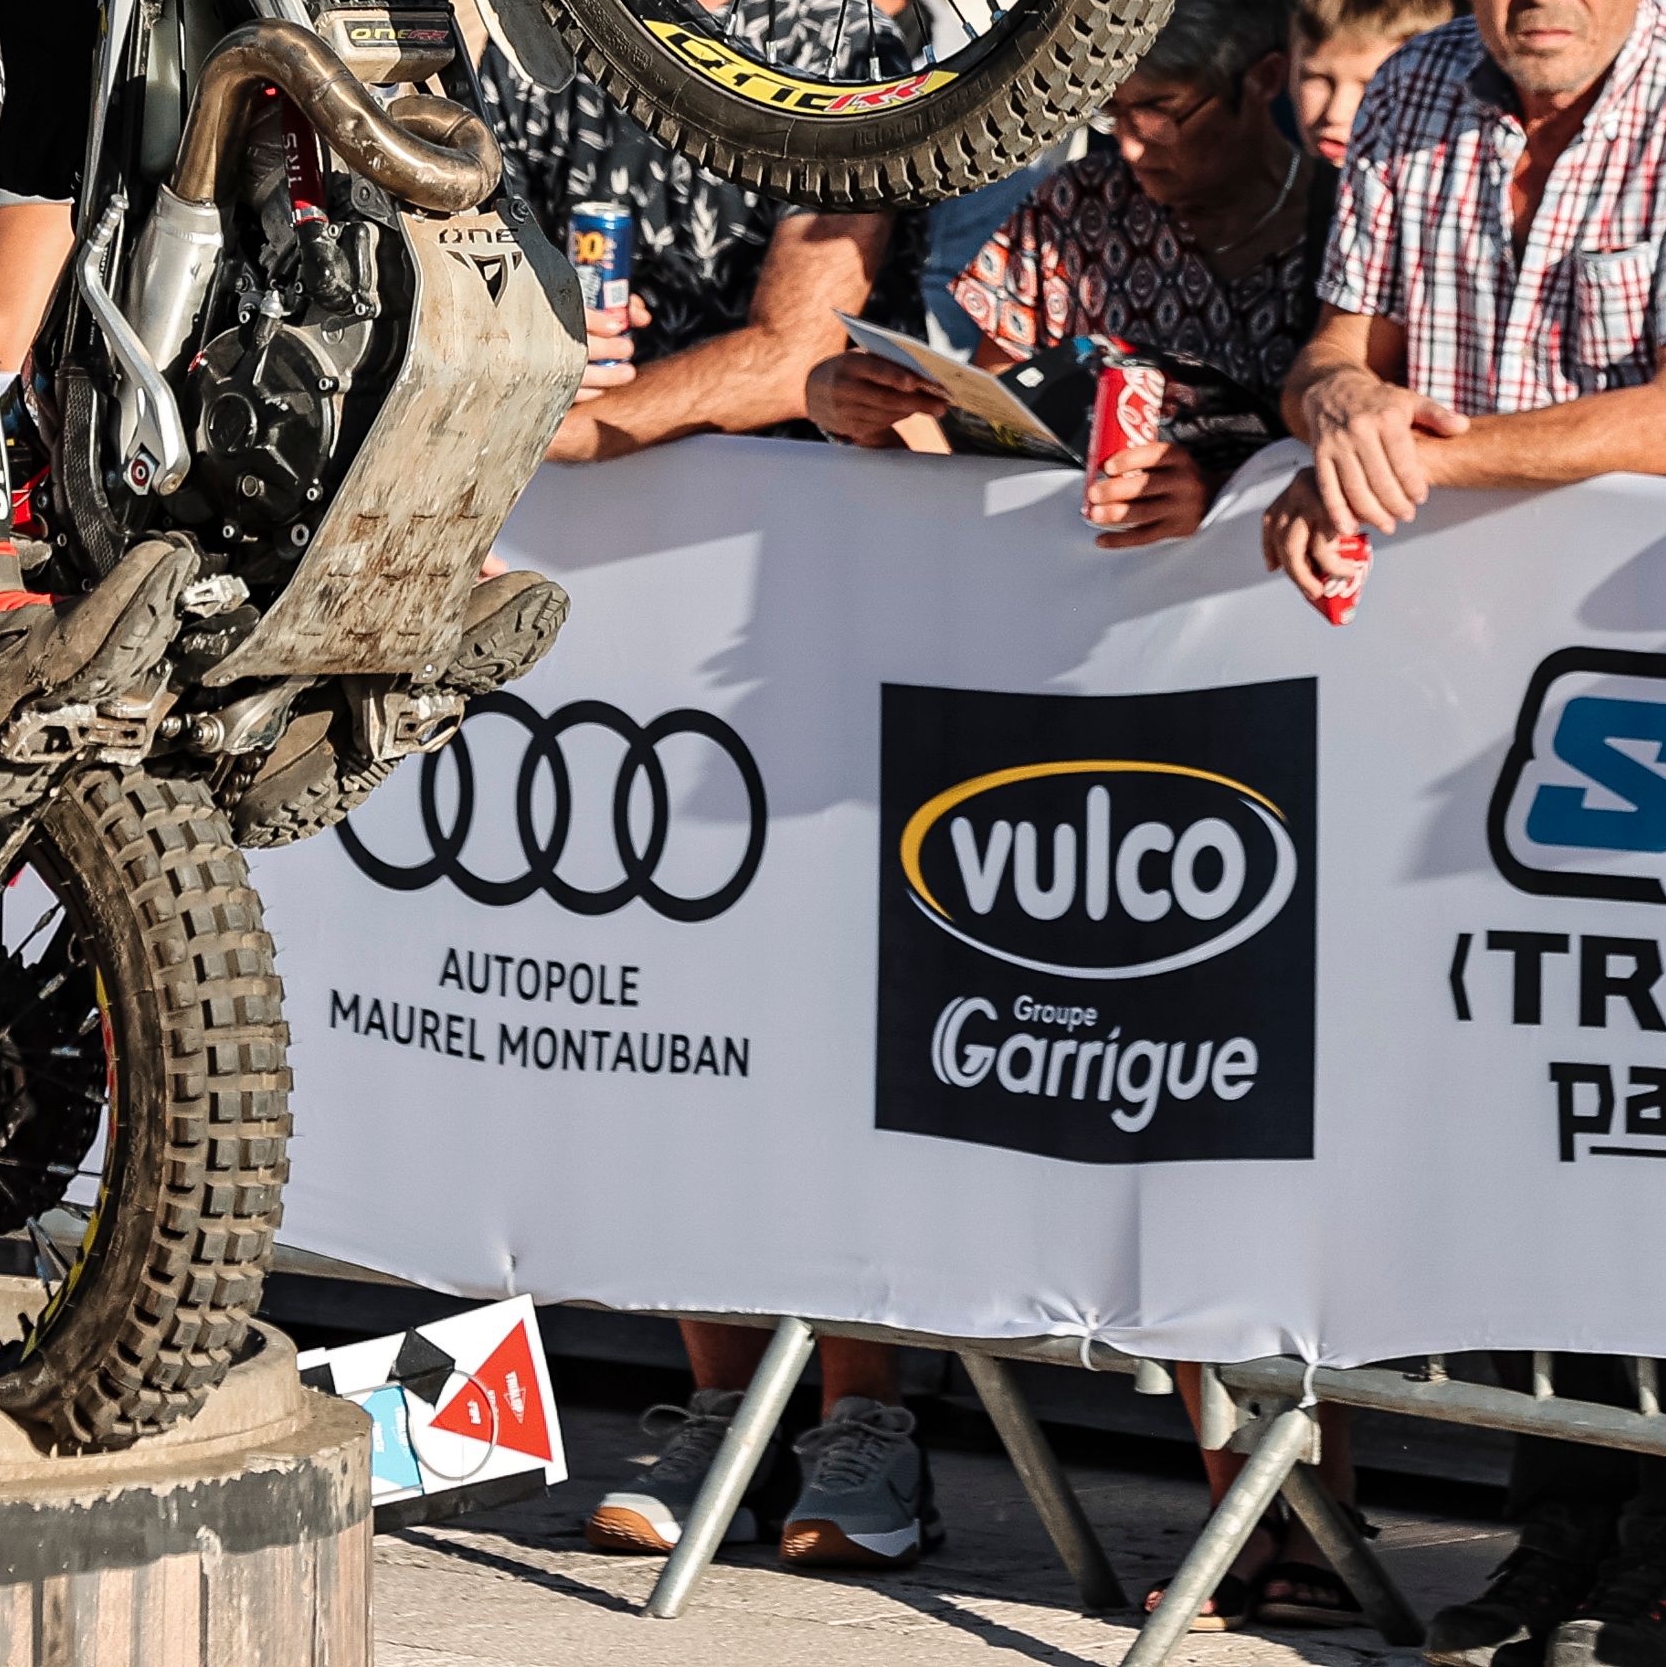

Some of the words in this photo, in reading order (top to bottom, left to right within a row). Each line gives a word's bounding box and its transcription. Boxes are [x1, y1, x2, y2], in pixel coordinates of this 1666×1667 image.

[437, 947, 640, 1007] AUTOPOLE
[329, 989, 487, 1063] MAUREL
[497, 1024, 751, 1079] MONTAUBAN
[1013, 994, 1099, 1033] Groupe
